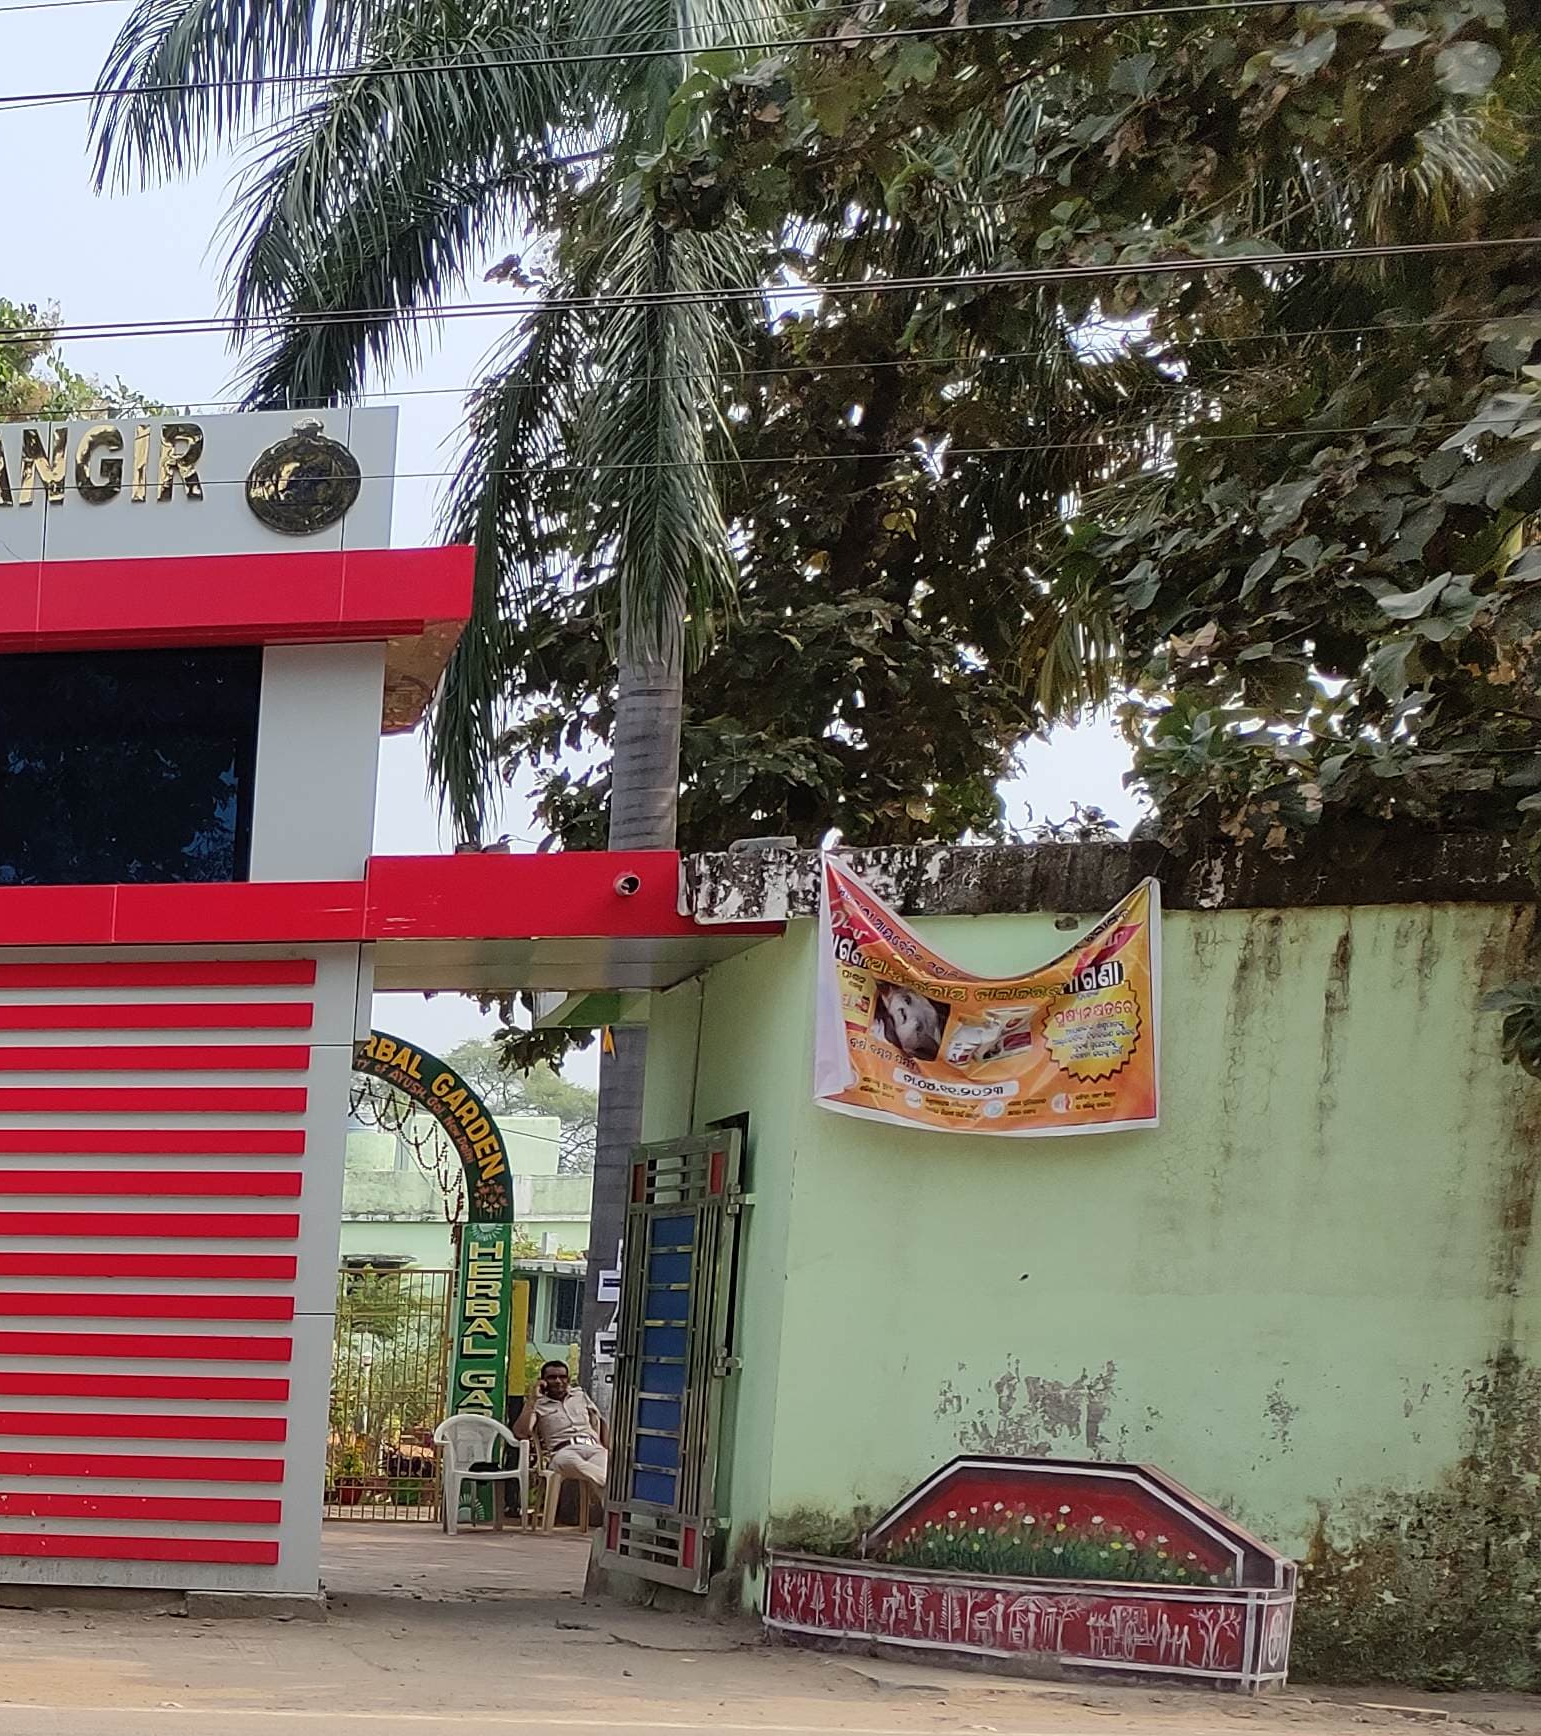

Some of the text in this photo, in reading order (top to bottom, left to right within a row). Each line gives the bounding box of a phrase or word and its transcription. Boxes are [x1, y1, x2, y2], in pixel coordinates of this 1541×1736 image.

[364, 1035, 506, 1182] RBAL GARDEN
[461, 1241, 505, 1356] HERBAL
